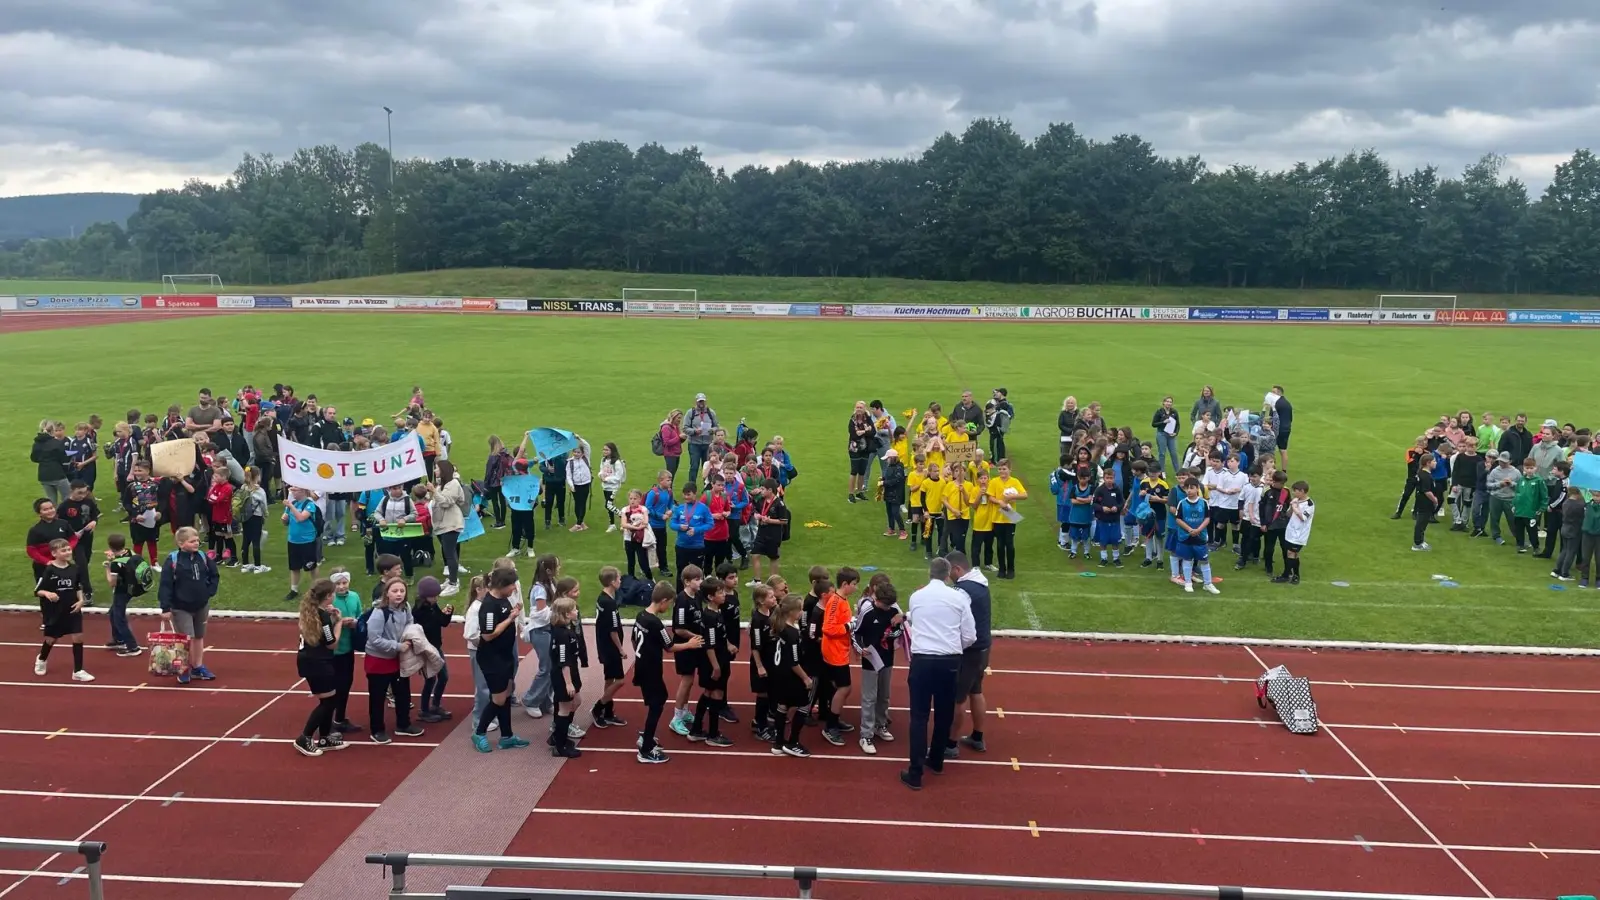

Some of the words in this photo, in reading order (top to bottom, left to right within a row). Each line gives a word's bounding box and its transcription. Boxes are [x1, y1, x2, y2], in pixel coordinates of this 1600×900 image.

[927, 307, 971, 315] Hochmuth
[1034, 307, 1075, 318] AGROB
[1076, 307, 1136, 318] BUCHTAL
[284, 453, 311, 473] GS
[336, 448, 417, 477] TEUNZ
[57, 578, 72, 587] ring
